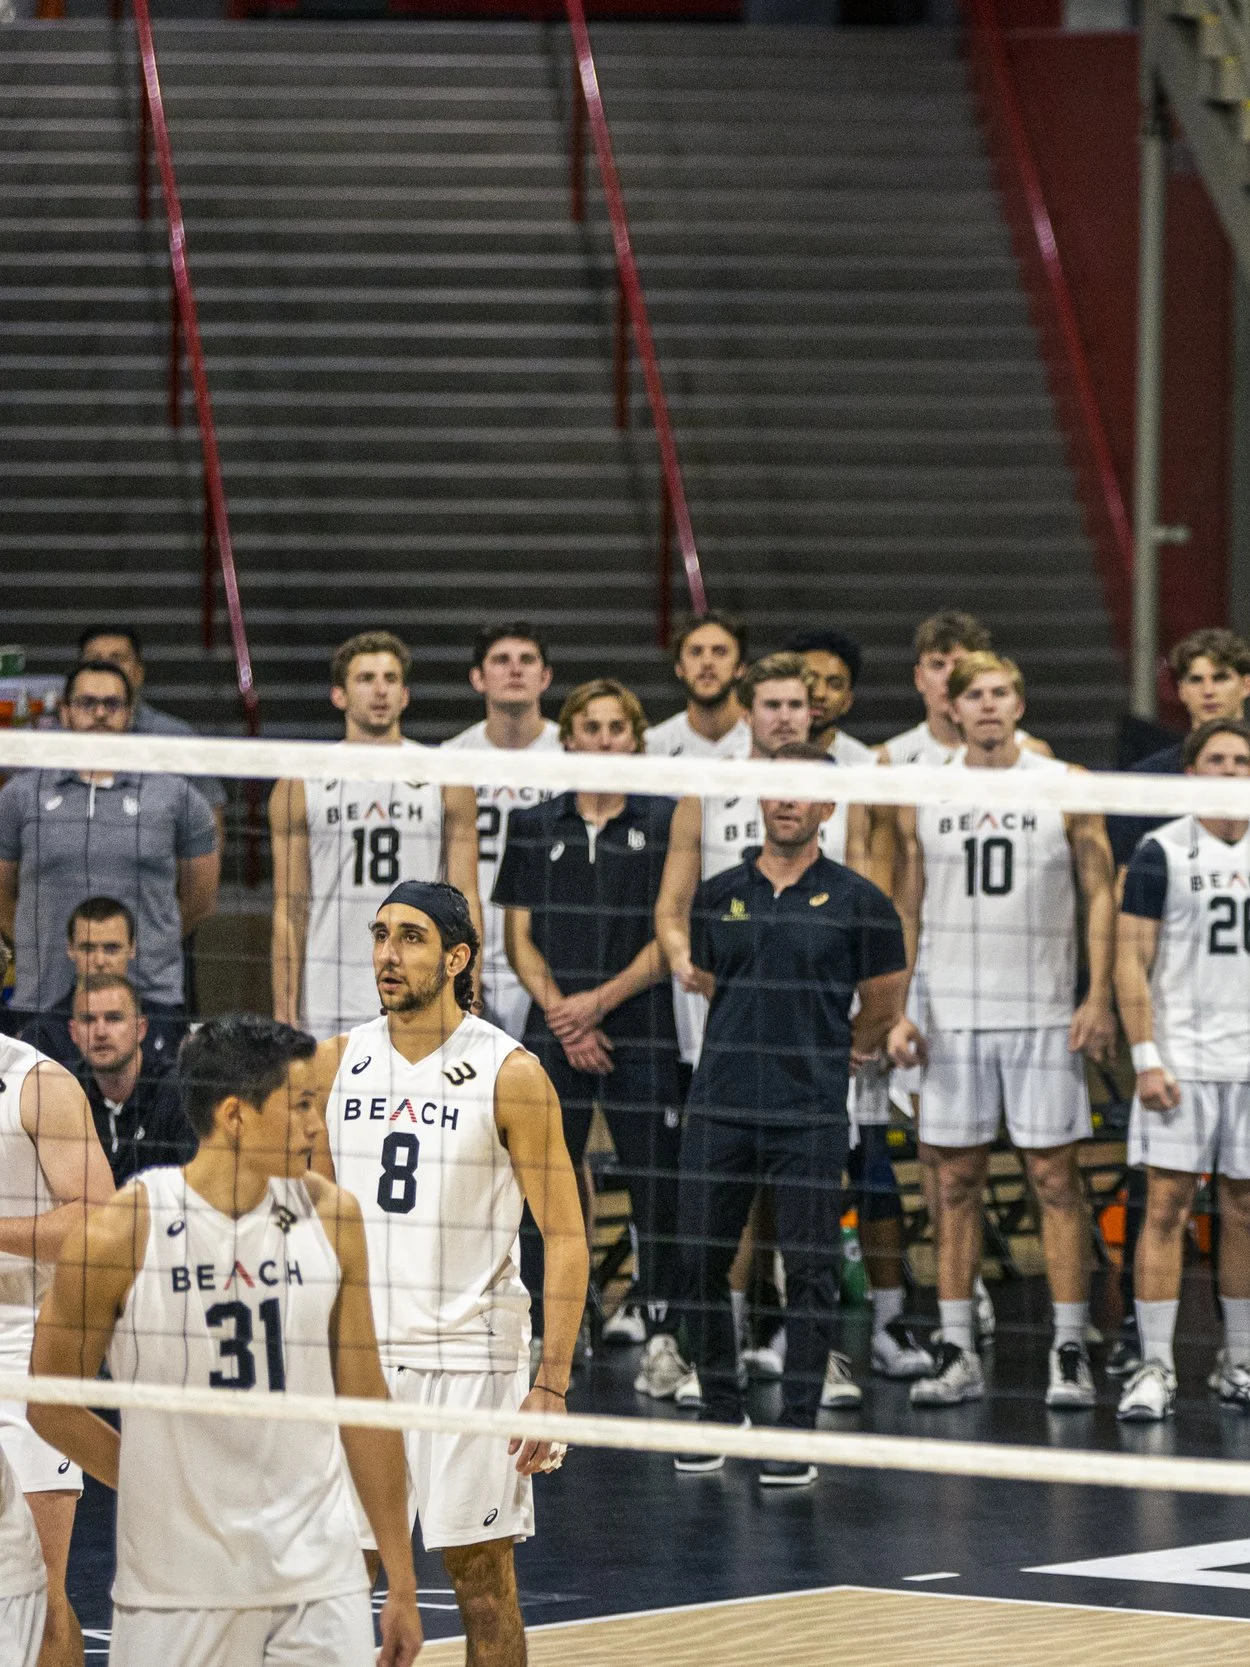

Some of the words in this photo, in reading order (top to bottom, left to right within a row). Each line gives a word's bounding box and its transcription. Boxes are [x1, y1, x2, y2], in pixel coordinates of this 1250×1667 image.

[326, 800, 424, 825] BEACH
[938, 810, 1037, 834] BEACH
[352, 826, 400, 886] 18
[965, 837, 1013, 897] 10
[344, 1098, 459, 1130] BEACH
[377, 1131, 420, 1214] 8
[171, 1260, 303, 1293] BEACH
[205, 1298, 286, 1393] 31
